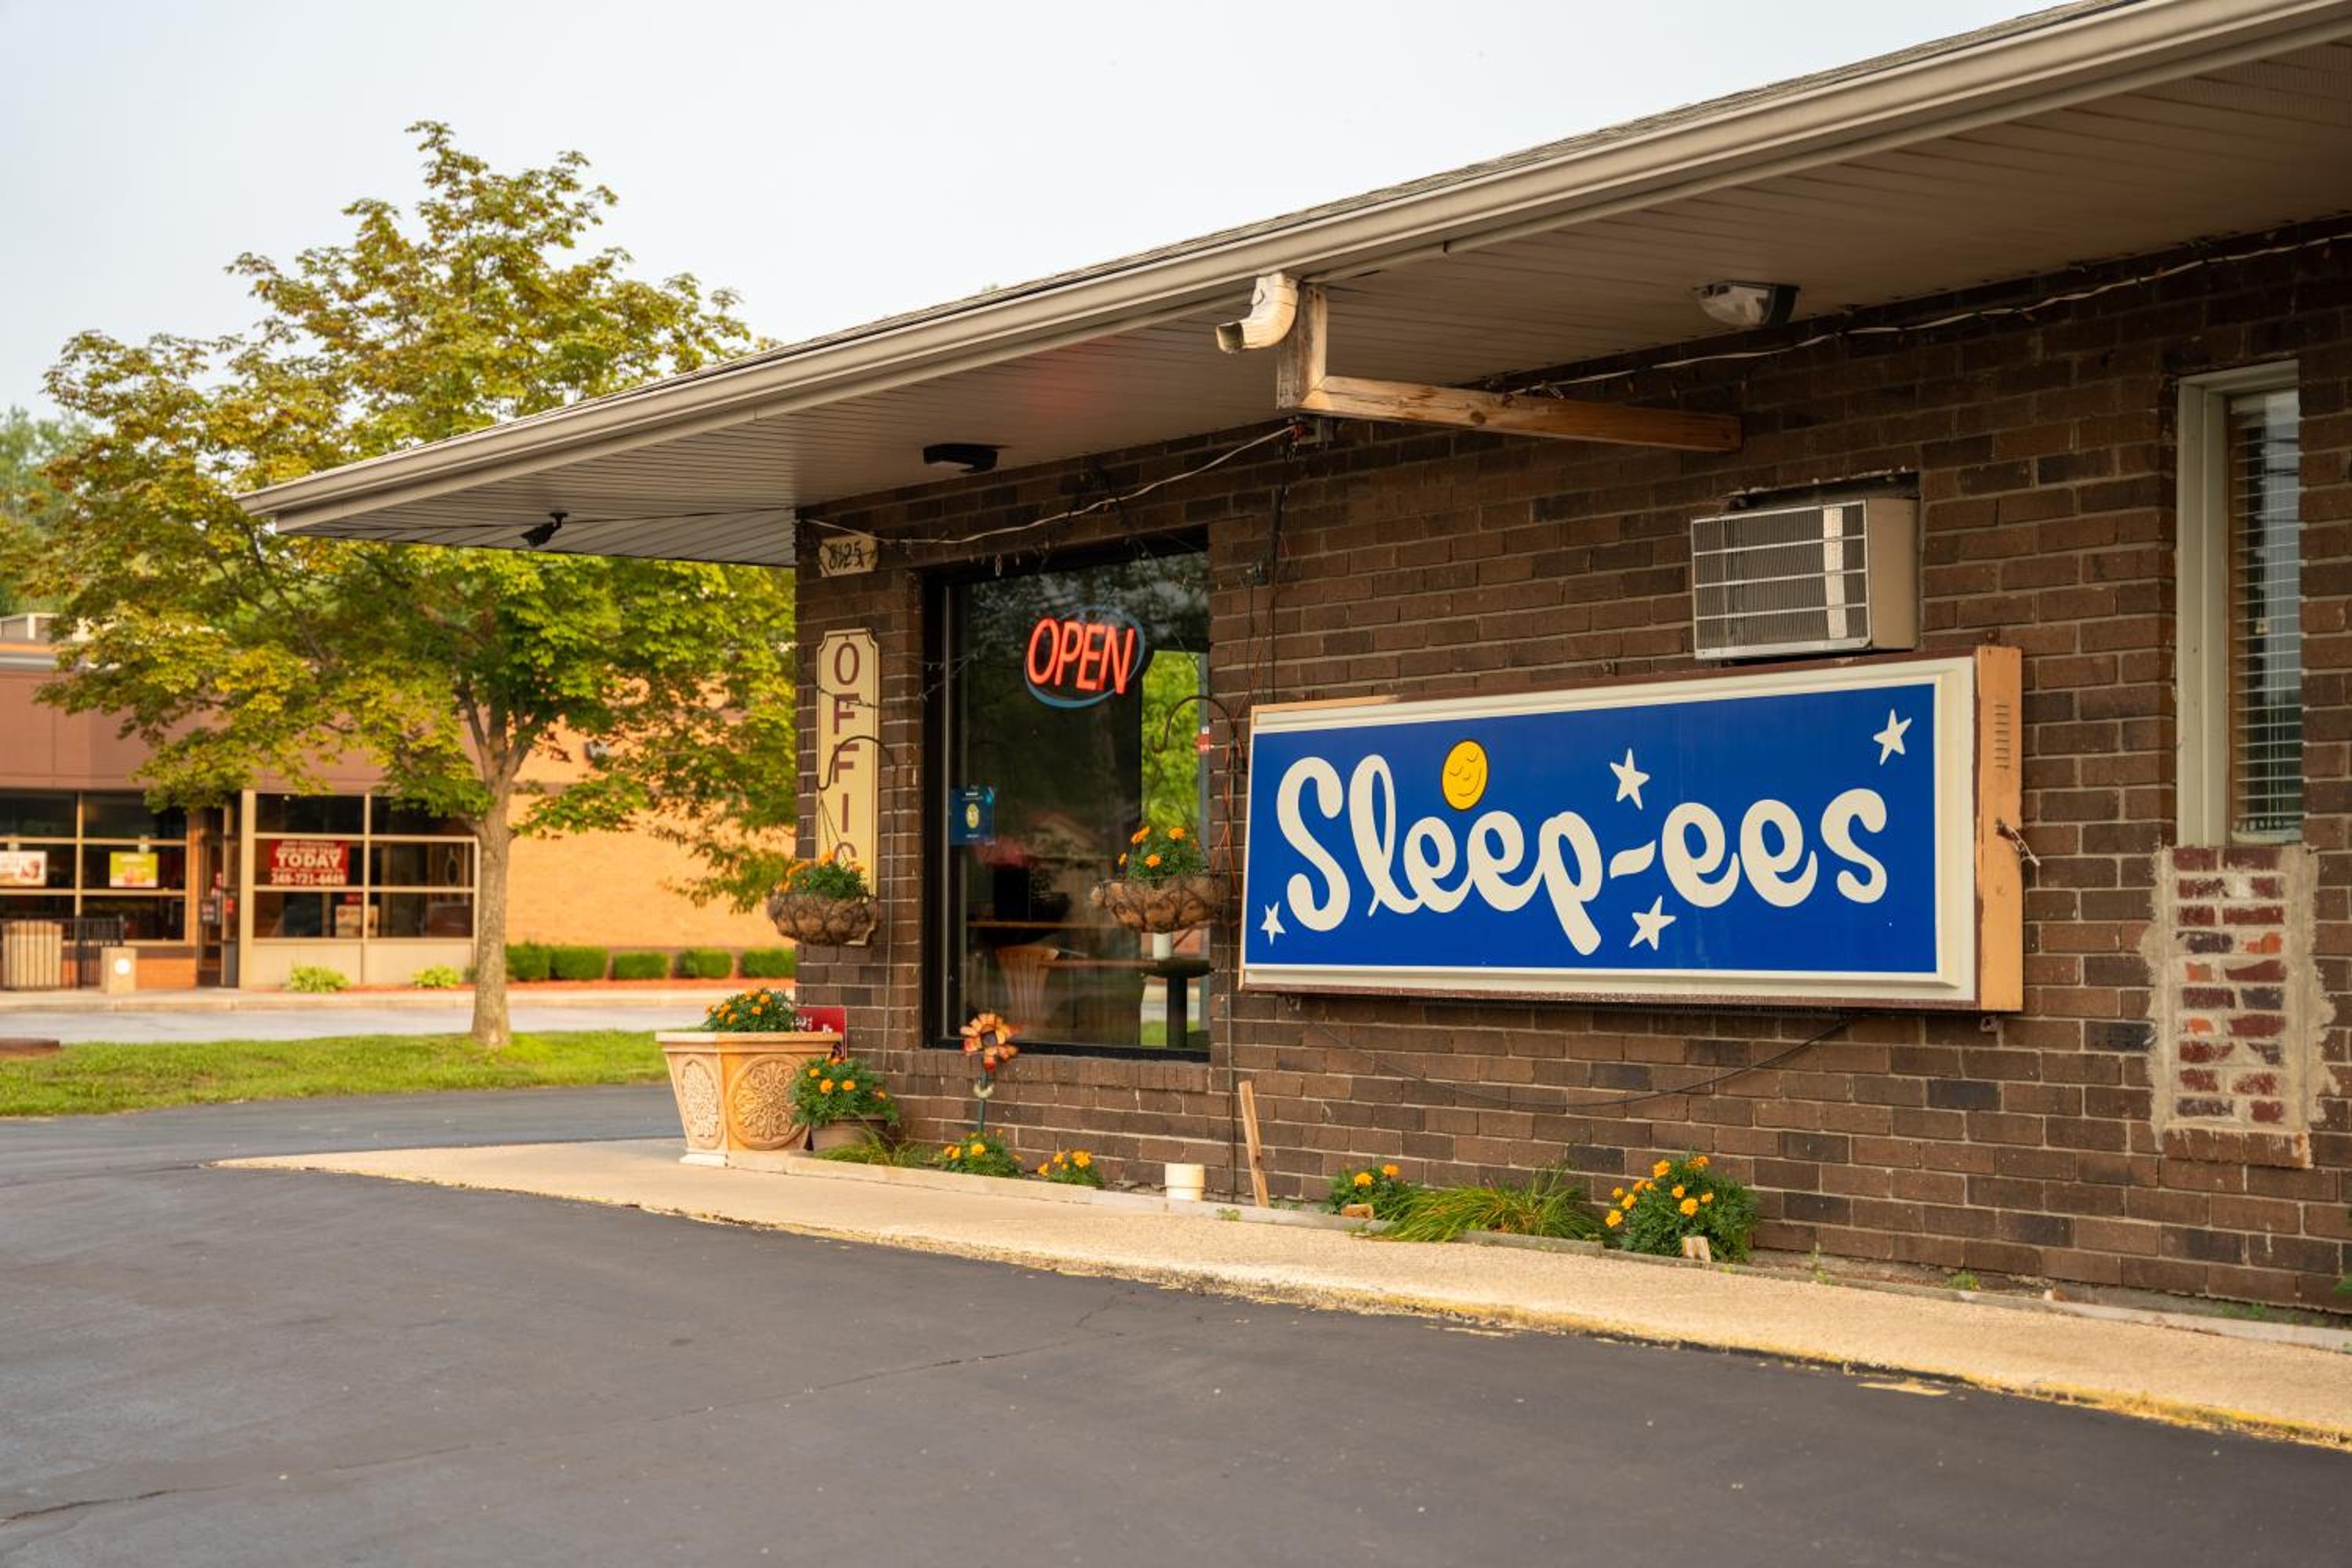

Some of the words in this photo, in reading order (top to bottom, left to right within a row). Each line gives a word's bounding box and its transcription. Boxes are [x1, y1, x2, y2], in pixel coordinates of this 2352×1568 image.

[1028, 616, 1136, 695] OPEN
[276, 851, 341, 868] TODAY
[1276, 753, 1887, 956] Sleep-ees
